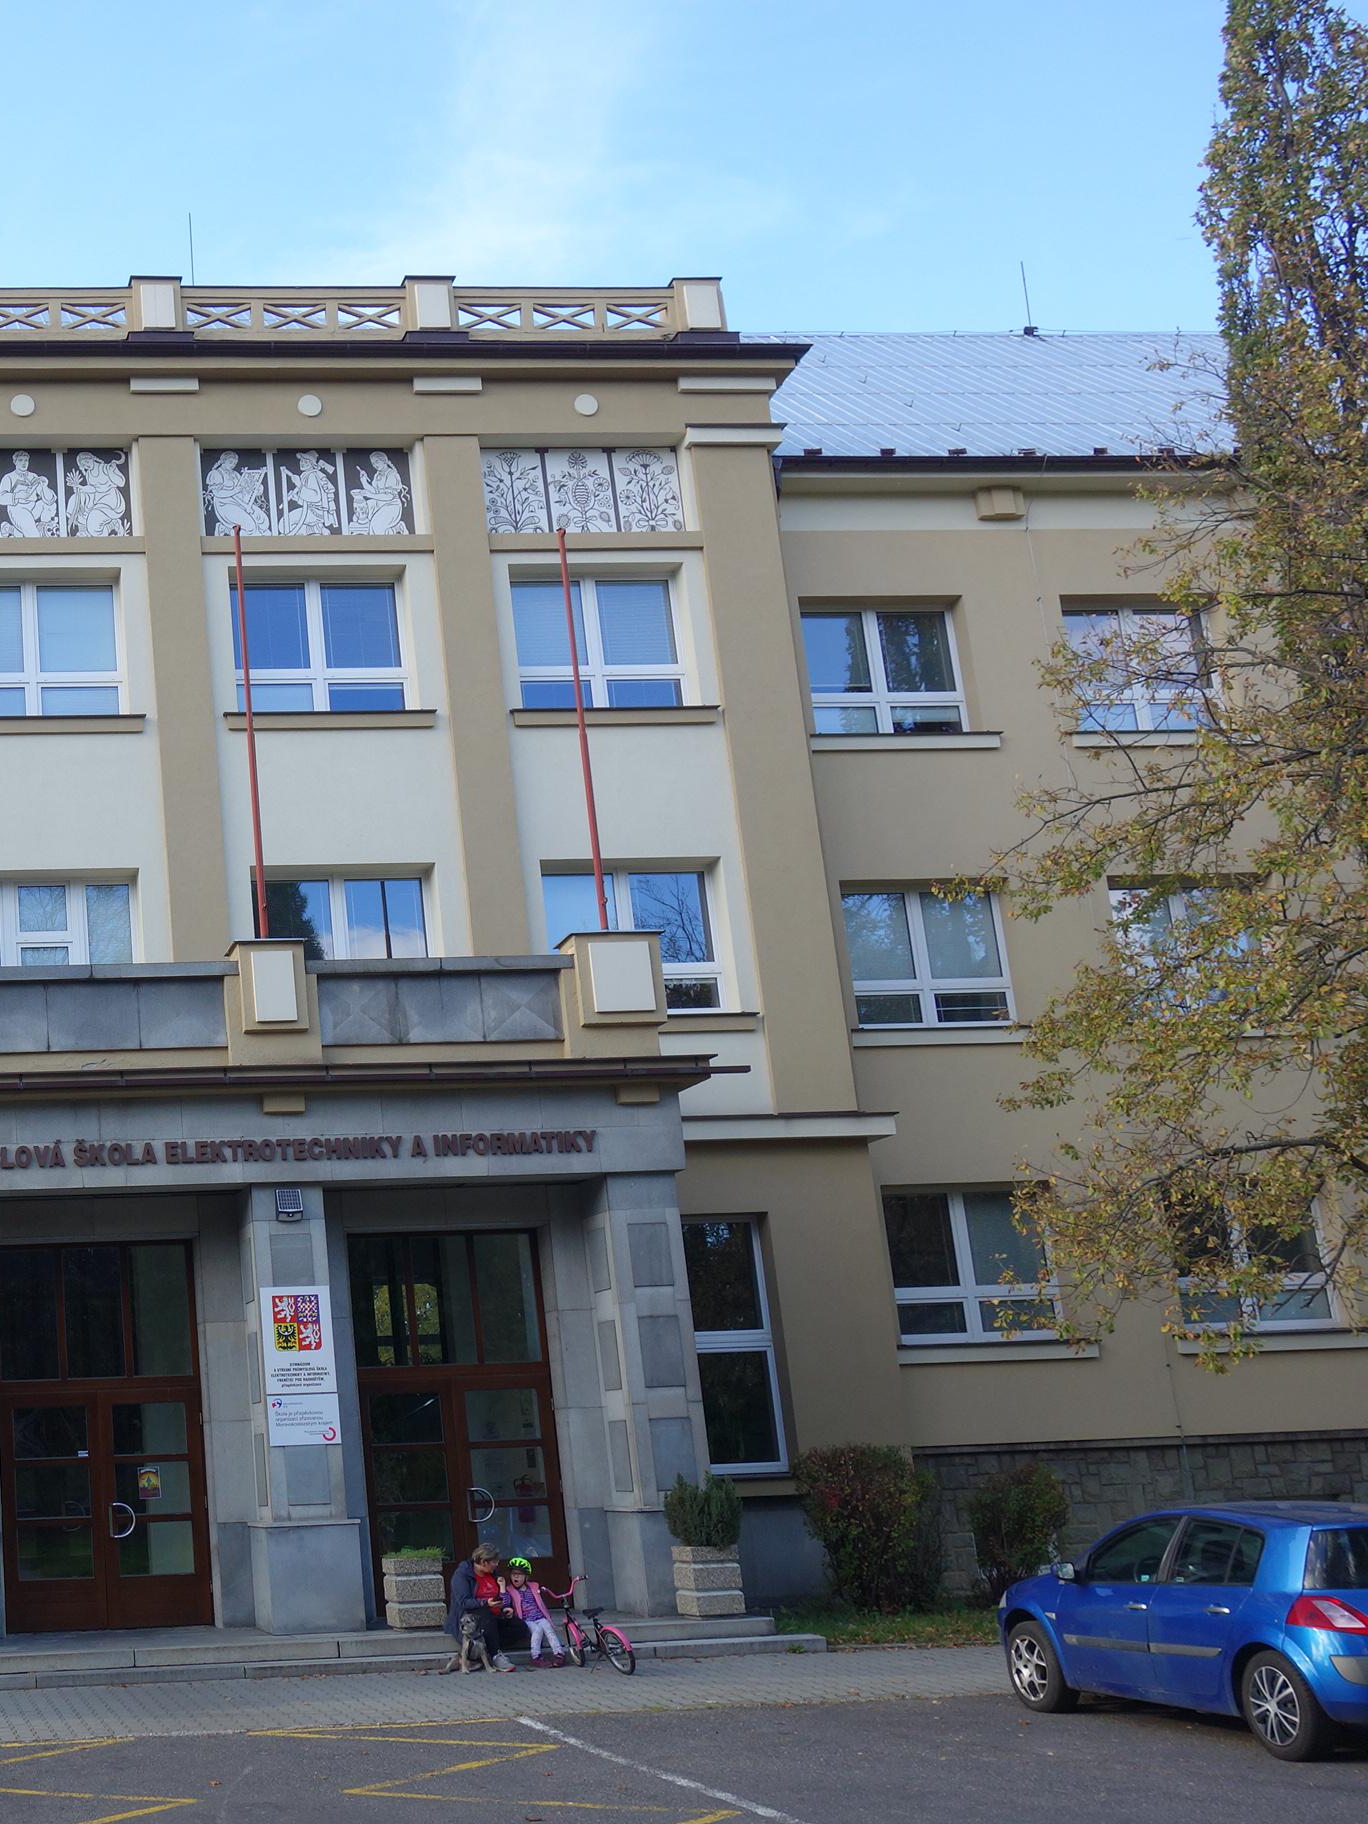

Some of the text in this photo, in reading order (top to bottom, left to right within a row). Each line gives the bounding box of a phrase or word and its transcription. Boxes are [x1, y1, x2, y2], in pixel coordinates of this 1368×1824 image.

[73, 1139, 157, 1168] ŠKOLA
[165, 1136, 402, 1165] ELEKTROTECHNIKY
[411, 1136, 429, 1158] A
[434, 1131, 597, 1157] INFORMATIKY
